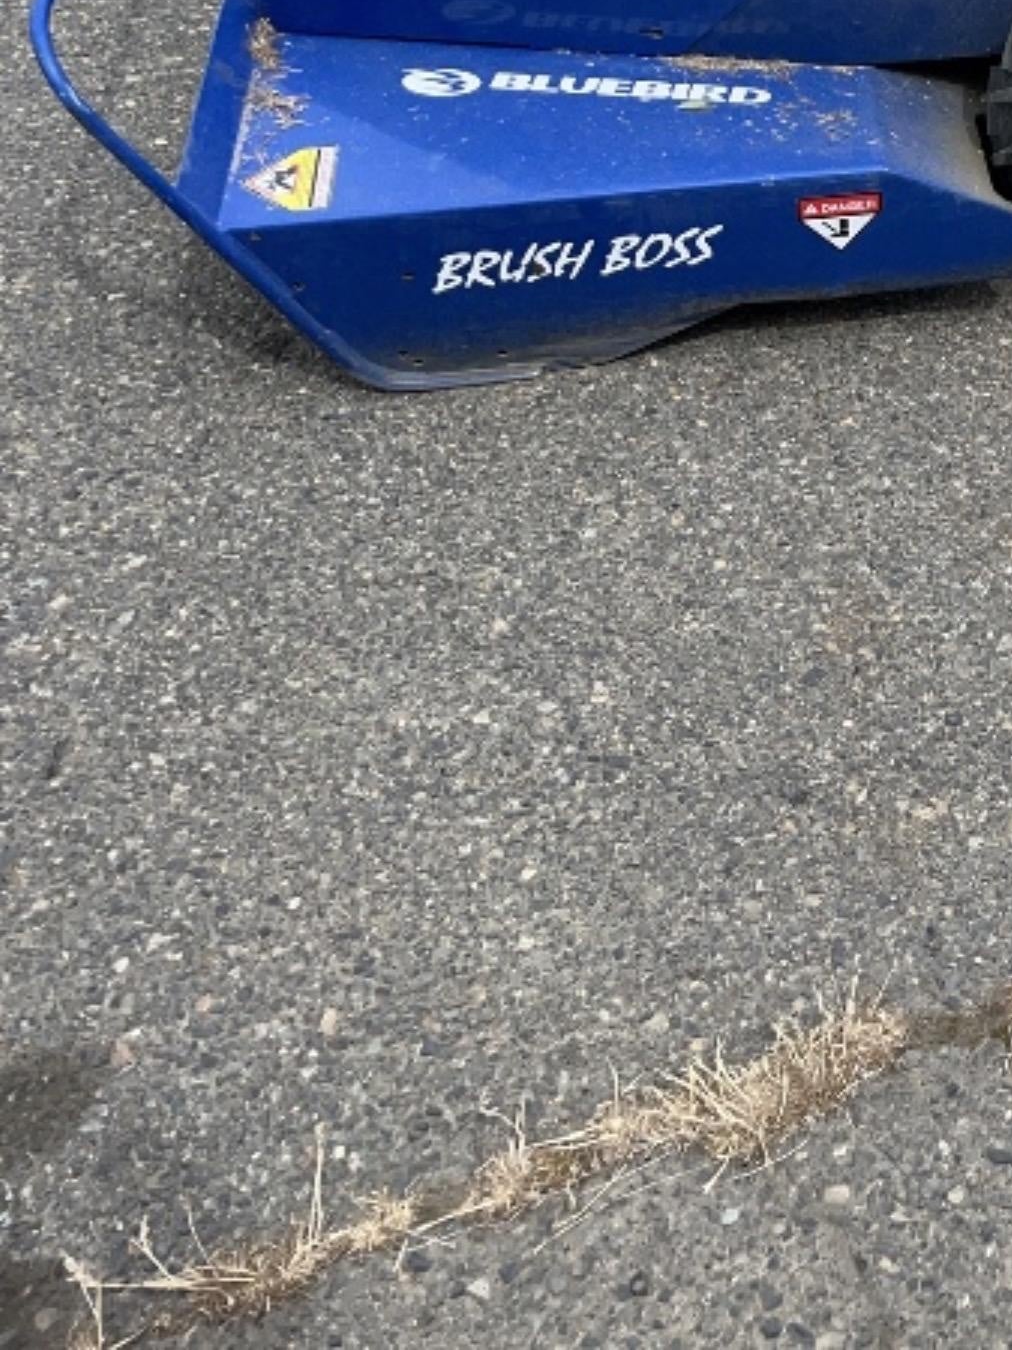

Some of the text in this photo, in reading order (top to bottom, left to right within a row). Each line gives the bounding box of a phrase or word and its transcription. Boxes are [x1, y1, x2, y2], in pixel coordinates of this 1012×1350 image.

[489, 71, 772, 104] BLUEBIRD
[821, 200, 878, 214] DANGER
[432, 225, 724, 294] BRUSH BOSS
